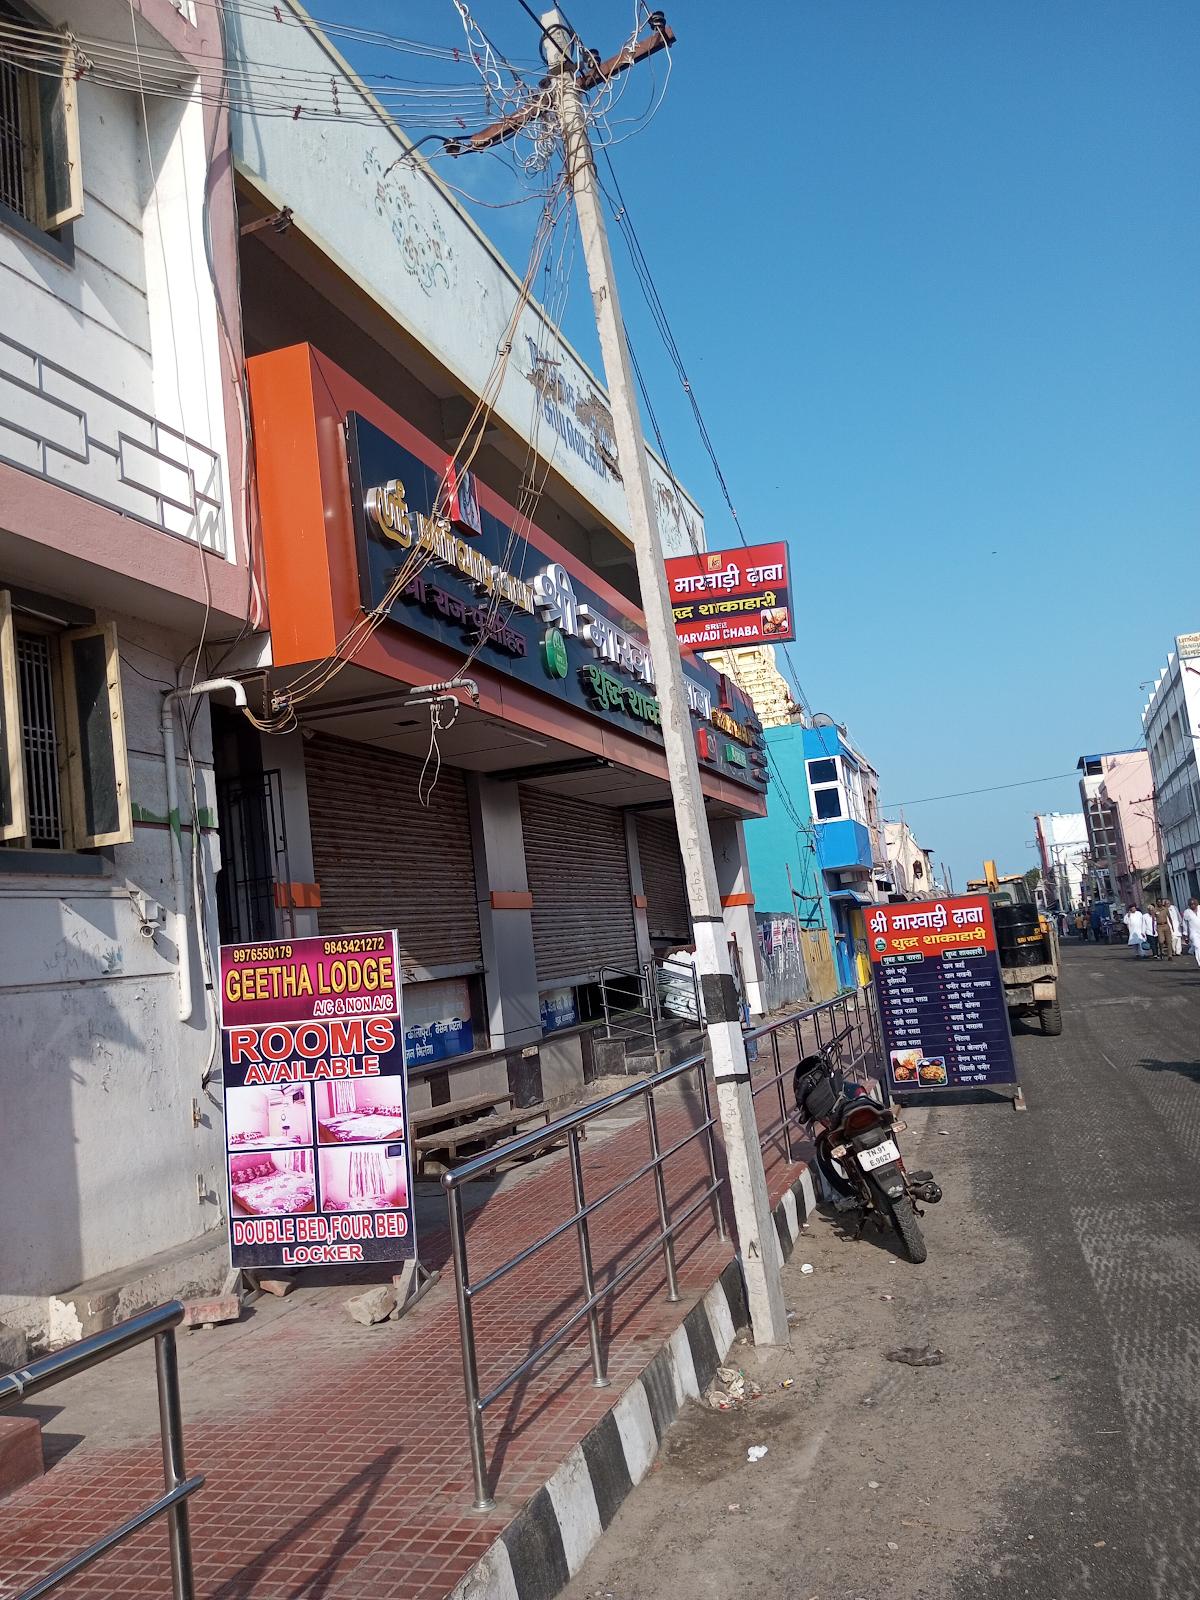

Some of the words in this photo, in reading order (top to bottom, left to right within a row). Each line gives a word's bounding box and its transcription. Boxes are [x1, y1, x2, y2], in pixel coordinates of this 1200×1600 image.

[674, 563, 740, 593] मारवाड़ी
[534, 563, 578, 637] श्री
[698, 590, 777, 616] शाकाहारी
[676, 630, 721, 645] MARVADI
[723, 625, 759, 640] DHABA
[704, 622, 728, 631] SREE
[869, 910, 888, 933] श्री
[891, 903, 948, 932] मारवाड़ी
[922, 926, 986, 945] शाकाहारी
[233, 945, 293, 963] 9976550179
[324, 937, 385, 955] 9843421272
[225, 962, 314, 1002] GEETHA
[317, 956, 394, 995] LODGE
[313, 1002, 335, 1016] A/C
[336, 1000, 346, 1014] &
[345, 997, 372, 1014] NON
[373, 994, 394, 1011] A/C
[229, 1018, 396, 1064] ROOMS
[244, 1055, 381, 1085] AVAILABLE
[233, 1219, 295, 1246] DOUBLE
[376, 1212, 408, 1239] BED
[282, 1244, 364, 1264] LOCKER
